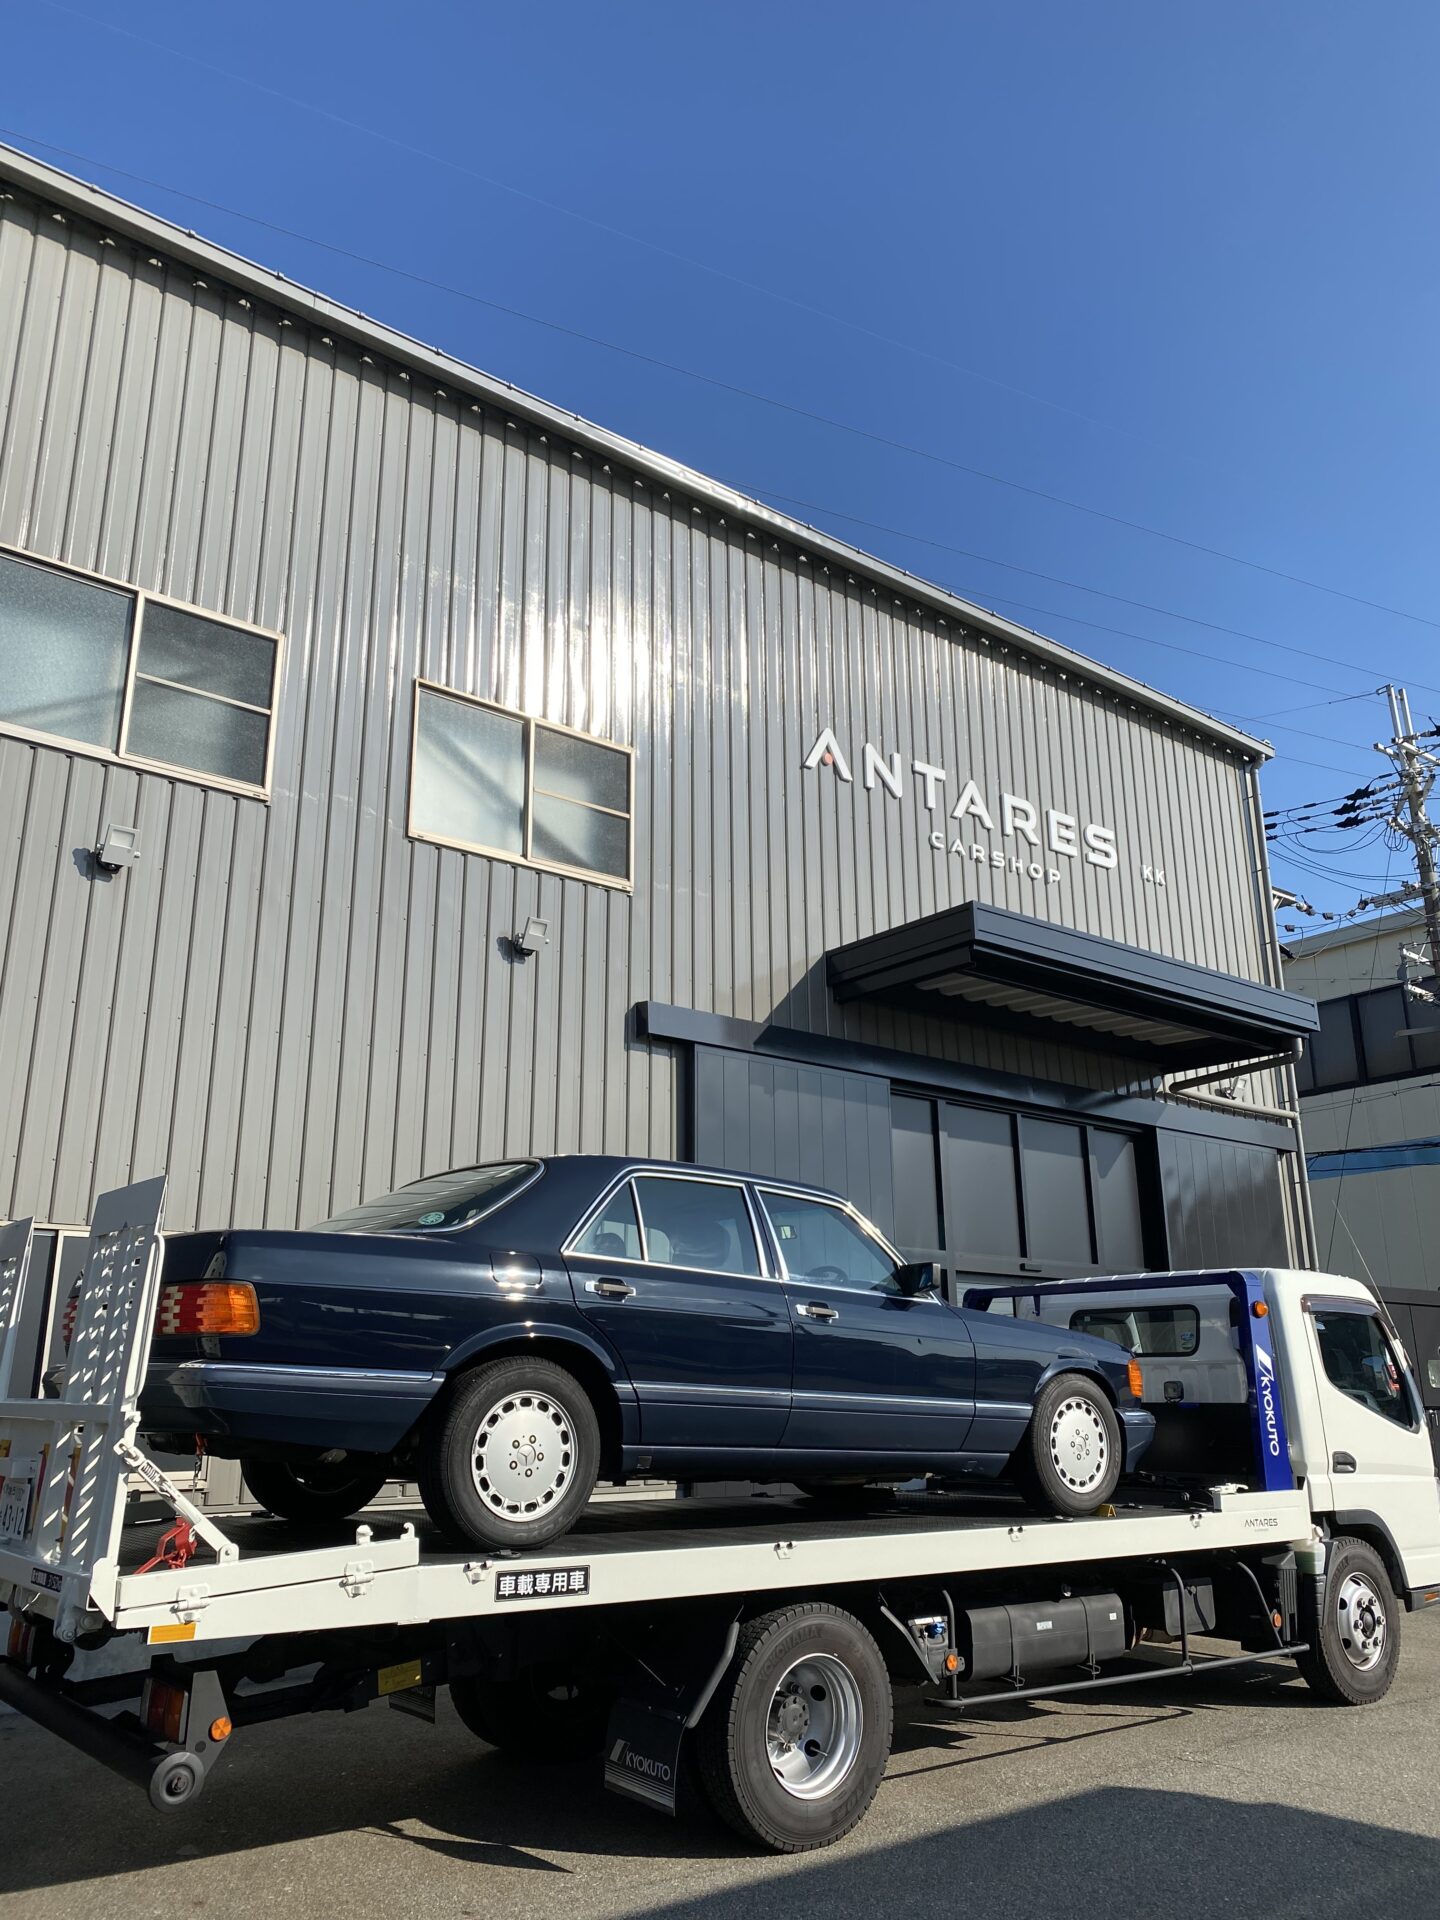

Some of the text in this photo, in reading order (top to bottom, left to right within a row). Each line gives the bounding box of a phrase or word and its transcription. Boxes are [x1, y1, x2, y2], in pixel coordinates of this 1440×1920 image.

[803, 727, 1118, 869] ANTARES
[929, 831, 1061, 884] CARSHOP
[1142, 864, 1166, 885] KK
[1260, 1376, 1280, 1456] KYOKUTO
[1244, 1518, 1279, 1528] ANTARES
[498, 1570, 586, 1597] 車載専用車
[625, 1751, 671, 1781] KYOKUTO
